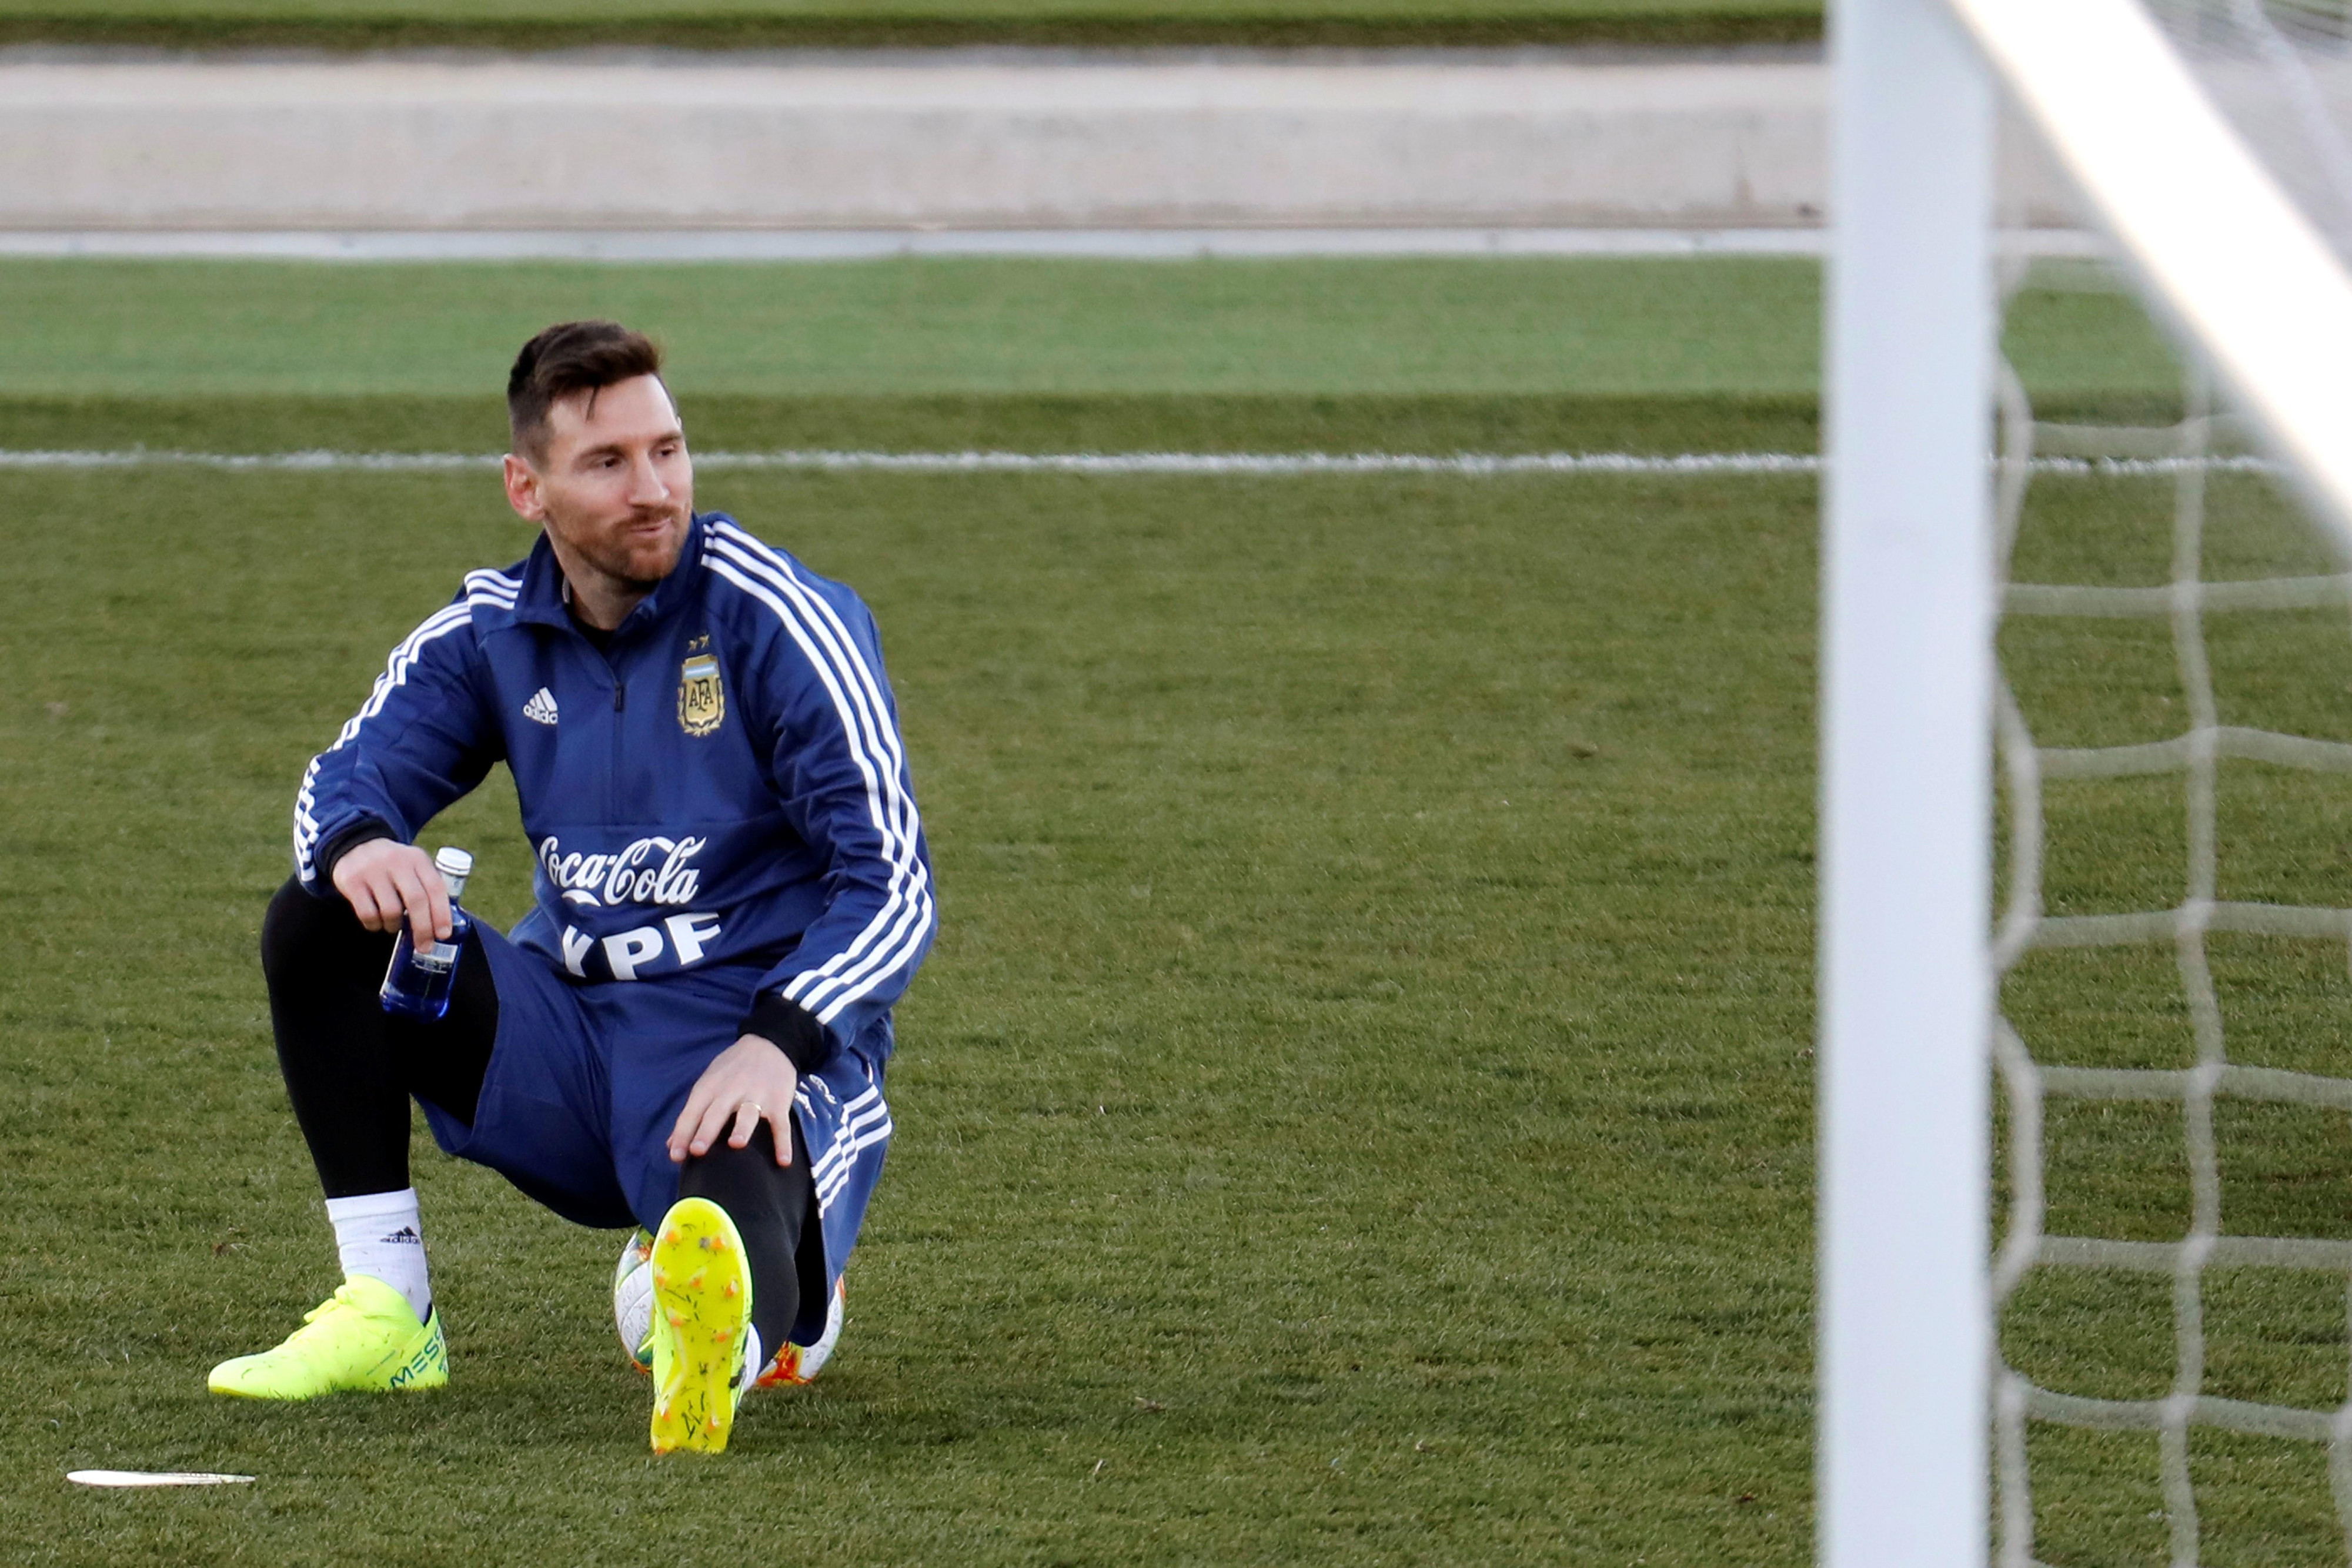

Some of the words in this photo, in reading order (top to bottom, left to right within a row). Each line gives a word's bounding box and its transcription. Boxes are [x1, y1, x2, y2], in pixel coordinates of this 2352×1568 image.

[523, 704, 558, 724] adida
[689, 678, 714, 711] AFA
[540, 835, 707, 907] Coca-Cola
[562, 912, 722, 980] YPF
